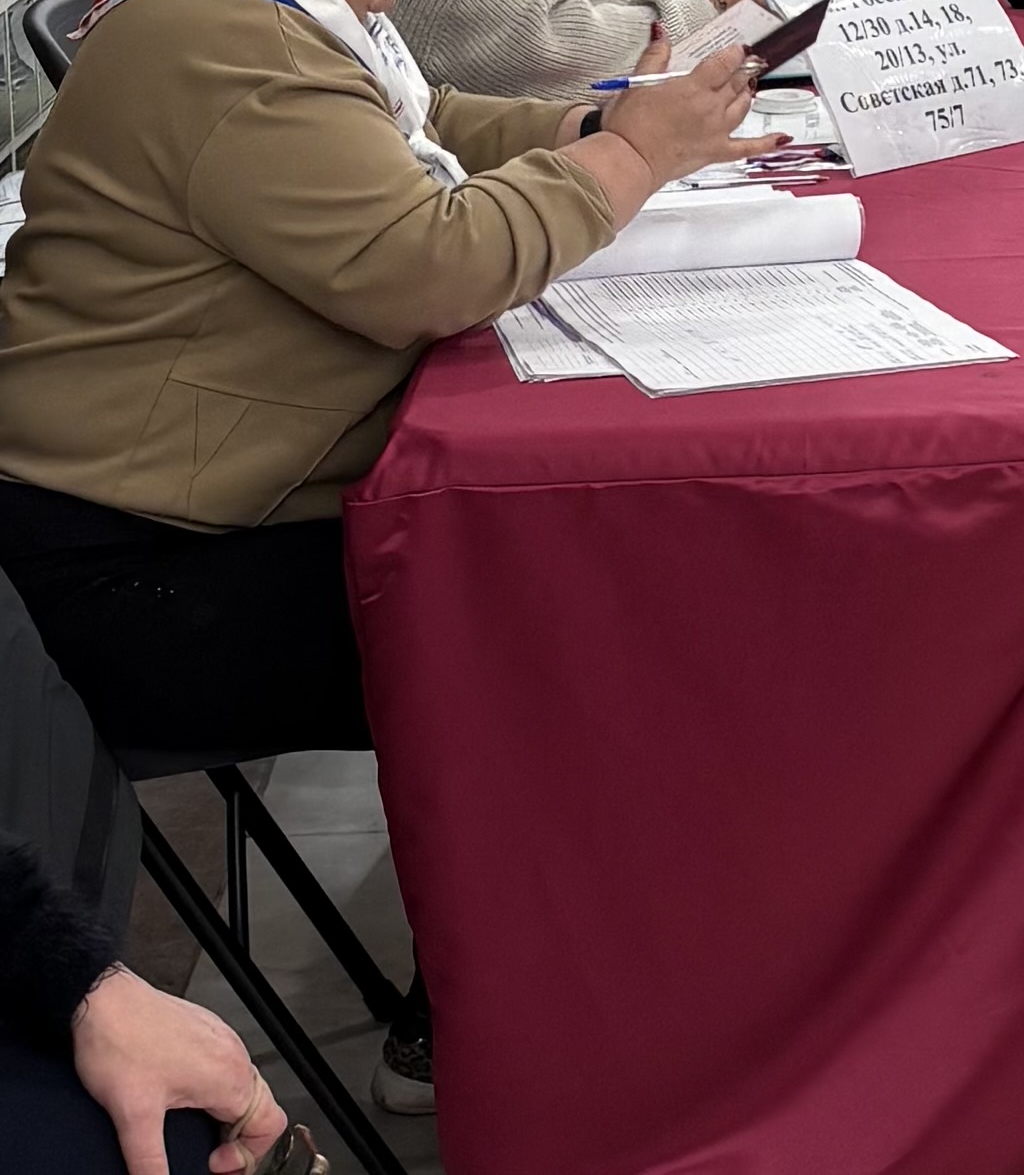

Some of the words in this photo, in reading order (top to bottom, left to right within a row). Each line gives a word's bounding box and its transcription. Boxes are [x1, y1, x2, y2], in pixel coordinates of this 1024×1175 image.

[838, 16, 891, 43] 12/30
[895, 9, 941, 35] д.14,
[940, 3, 973, 25] 18,
[874, 42, 935, 71] 20/13,
[935, 41, 967, 65] ул.
[840, 78, 947, 114] Советская
[951, 64, 996, 93] д.71,
[925, 104, 966, 132] 75/7
